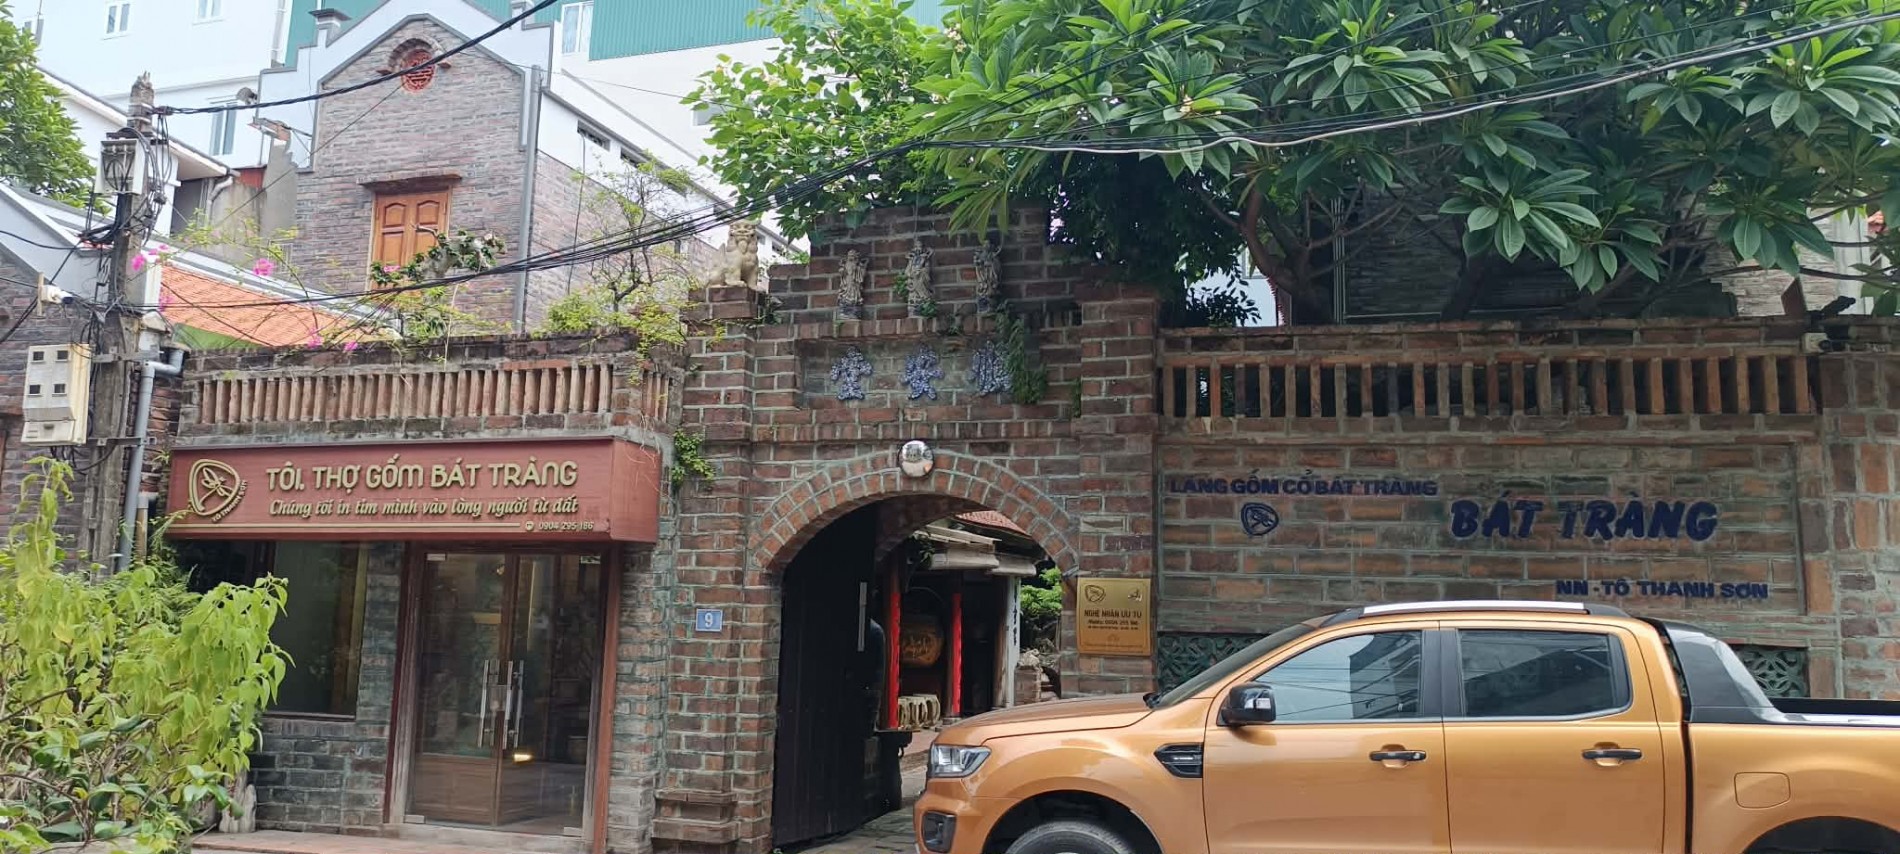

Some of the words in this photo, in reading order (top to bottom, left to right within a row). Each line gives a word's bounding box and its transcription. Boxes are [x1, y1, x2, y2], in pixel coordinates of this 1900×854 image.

[266, 461, 305, 491] TÔI.
[312, 465, 361, 494] THỢ
[366, 453, 424, 489] GỐM
[431, 457, 482, 488] BÁT
[488, 455, 578, 487] TRÀNG
[1230, 469, 1279, 495] GỐM
[1282, 469, 1314, 495] CỔ
[270, 500, 312, 519] Chúng
[315, 499, 335, 515] tôi
[337, 500, 351, 514] in
[355, 499, 378, 515] tim
[382, 499, 418, 515] mình
[422, 497, 447, 515] vào
[451, 498, 482, 518] lòng
[487, 497, 529, 518] người
[1451, 491, 1544, 539] BÁT
[1557, 491, 1719, 541] TRÀNG
[1556, 580, 1589, 597] NN
[1636, 580, 1716, 598] THANH
[704, 612, 714, 628] 9
